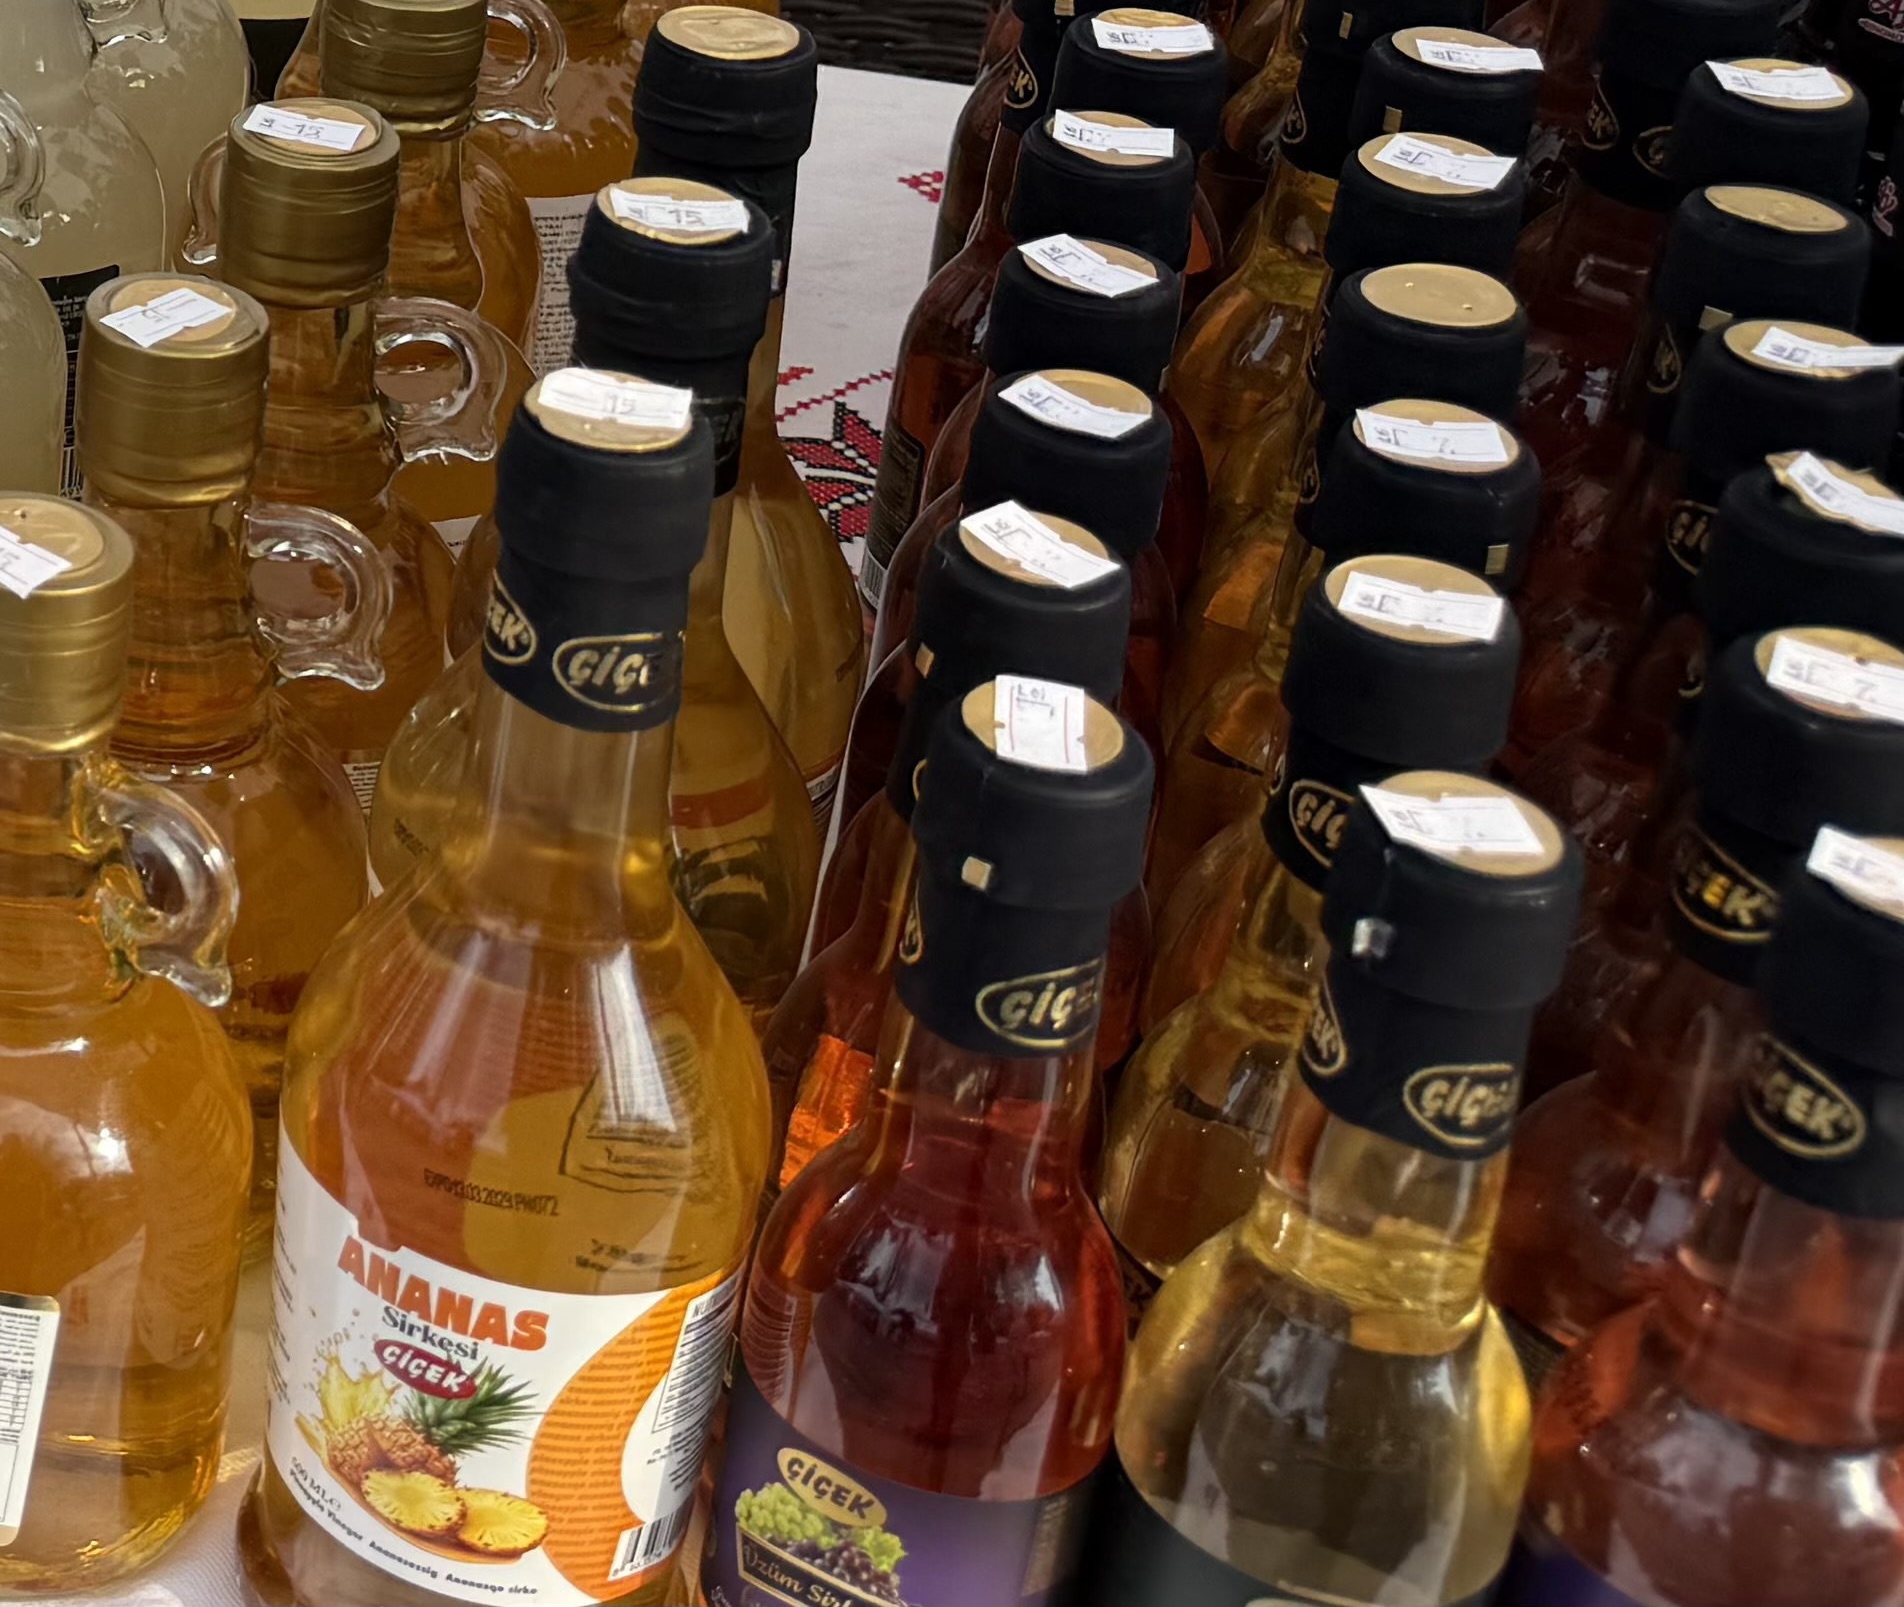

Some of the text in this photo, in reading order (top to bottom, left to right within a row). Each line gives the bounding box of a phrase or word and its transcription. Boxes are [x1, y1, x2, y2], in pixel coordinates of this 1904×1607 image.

[337, 1235, 551, 1353] ANANAS
[380, 1305, 482, 1362] Sirkesi
[382, 1342, 469, 1394] ÇİÇEK
[786, 1456, 875, 1521] ÇİÇEK
[744, 1544, 803, 1594] Üzüm
